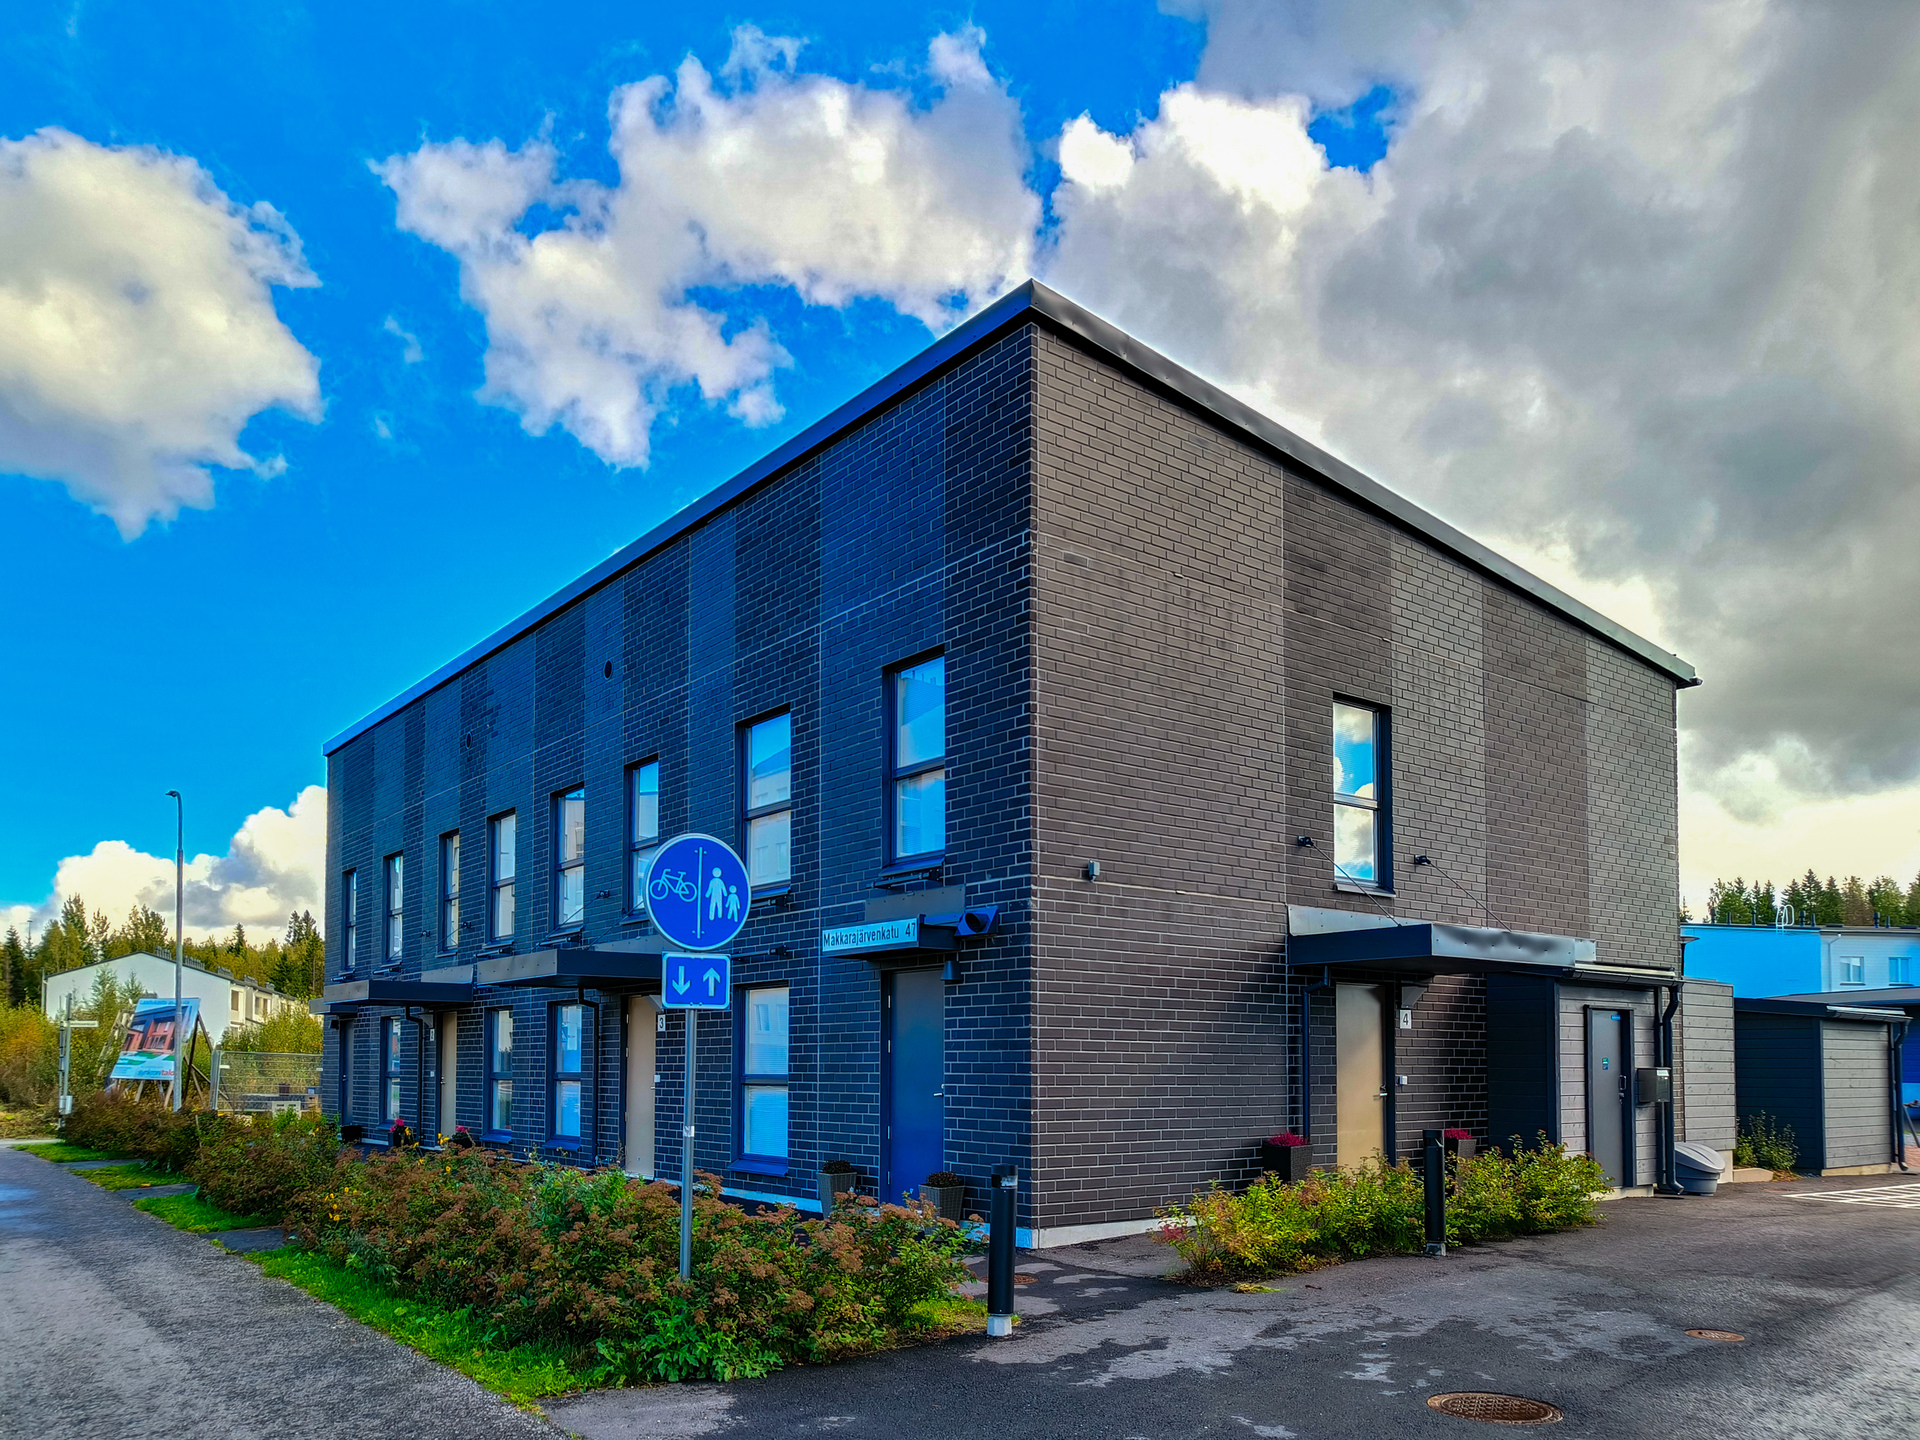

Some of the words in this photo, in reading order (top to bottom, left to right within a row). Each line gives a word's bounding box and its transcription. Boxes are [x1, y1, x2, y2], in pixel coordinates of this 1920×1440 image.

[823, 925, 899, 946] Makkarajärvenkatu
[906, 922, 916, 937] 47
[660, 1017, 664, 1028] 3
[1403, 1013, 1408, 1025] 4
